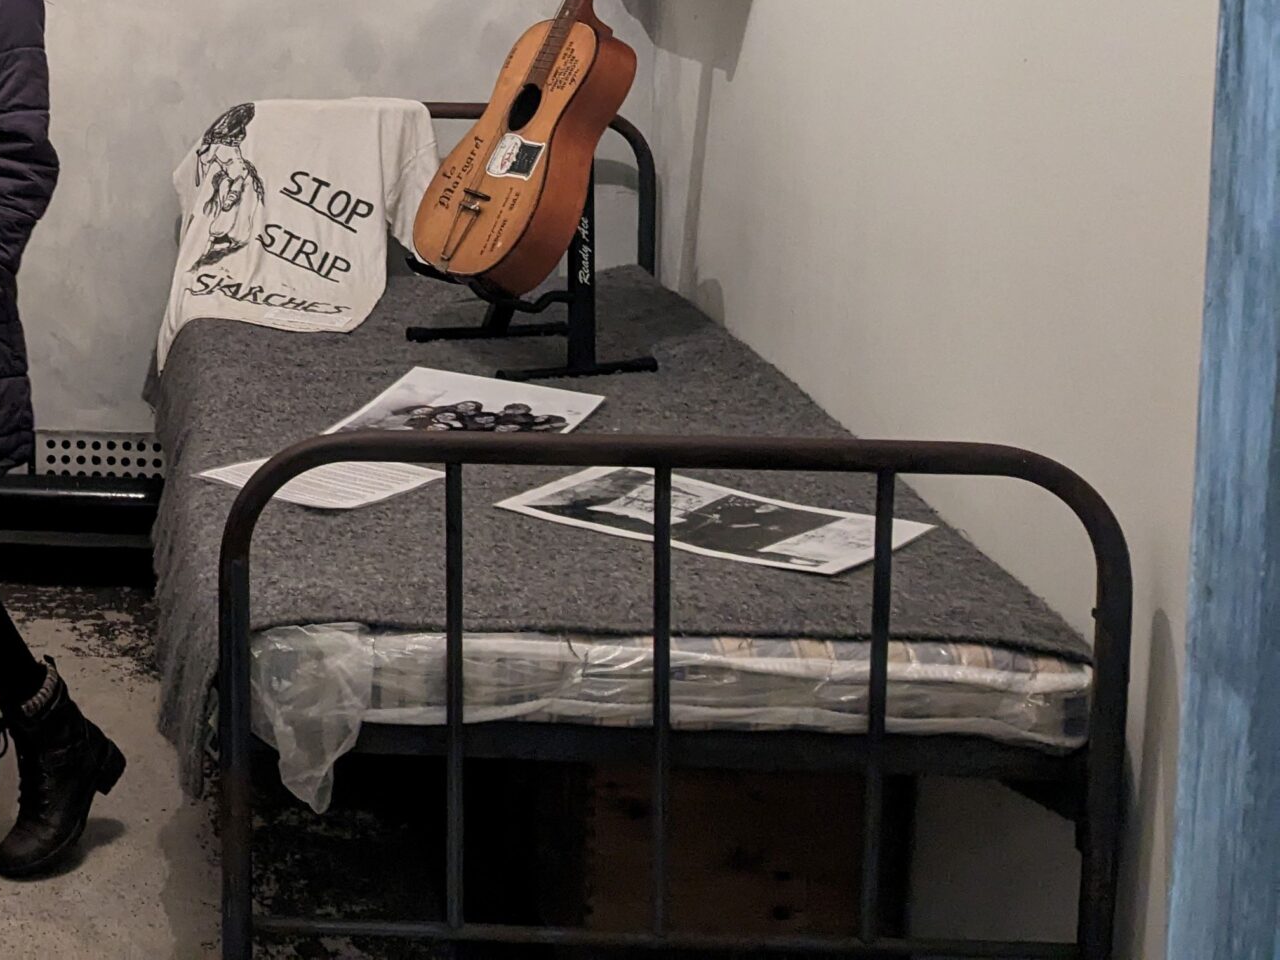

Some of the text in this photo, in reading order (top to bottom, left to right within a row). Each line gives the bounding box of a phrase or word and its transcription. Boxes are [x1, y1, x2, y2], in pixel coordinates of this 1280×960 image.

[281, 170, 374, 228] STOP
[436, 136, 484, 210] Margaret
[257, 224, 352, 281] STRIP
[577, 216, 592, 285] Ready Ace
